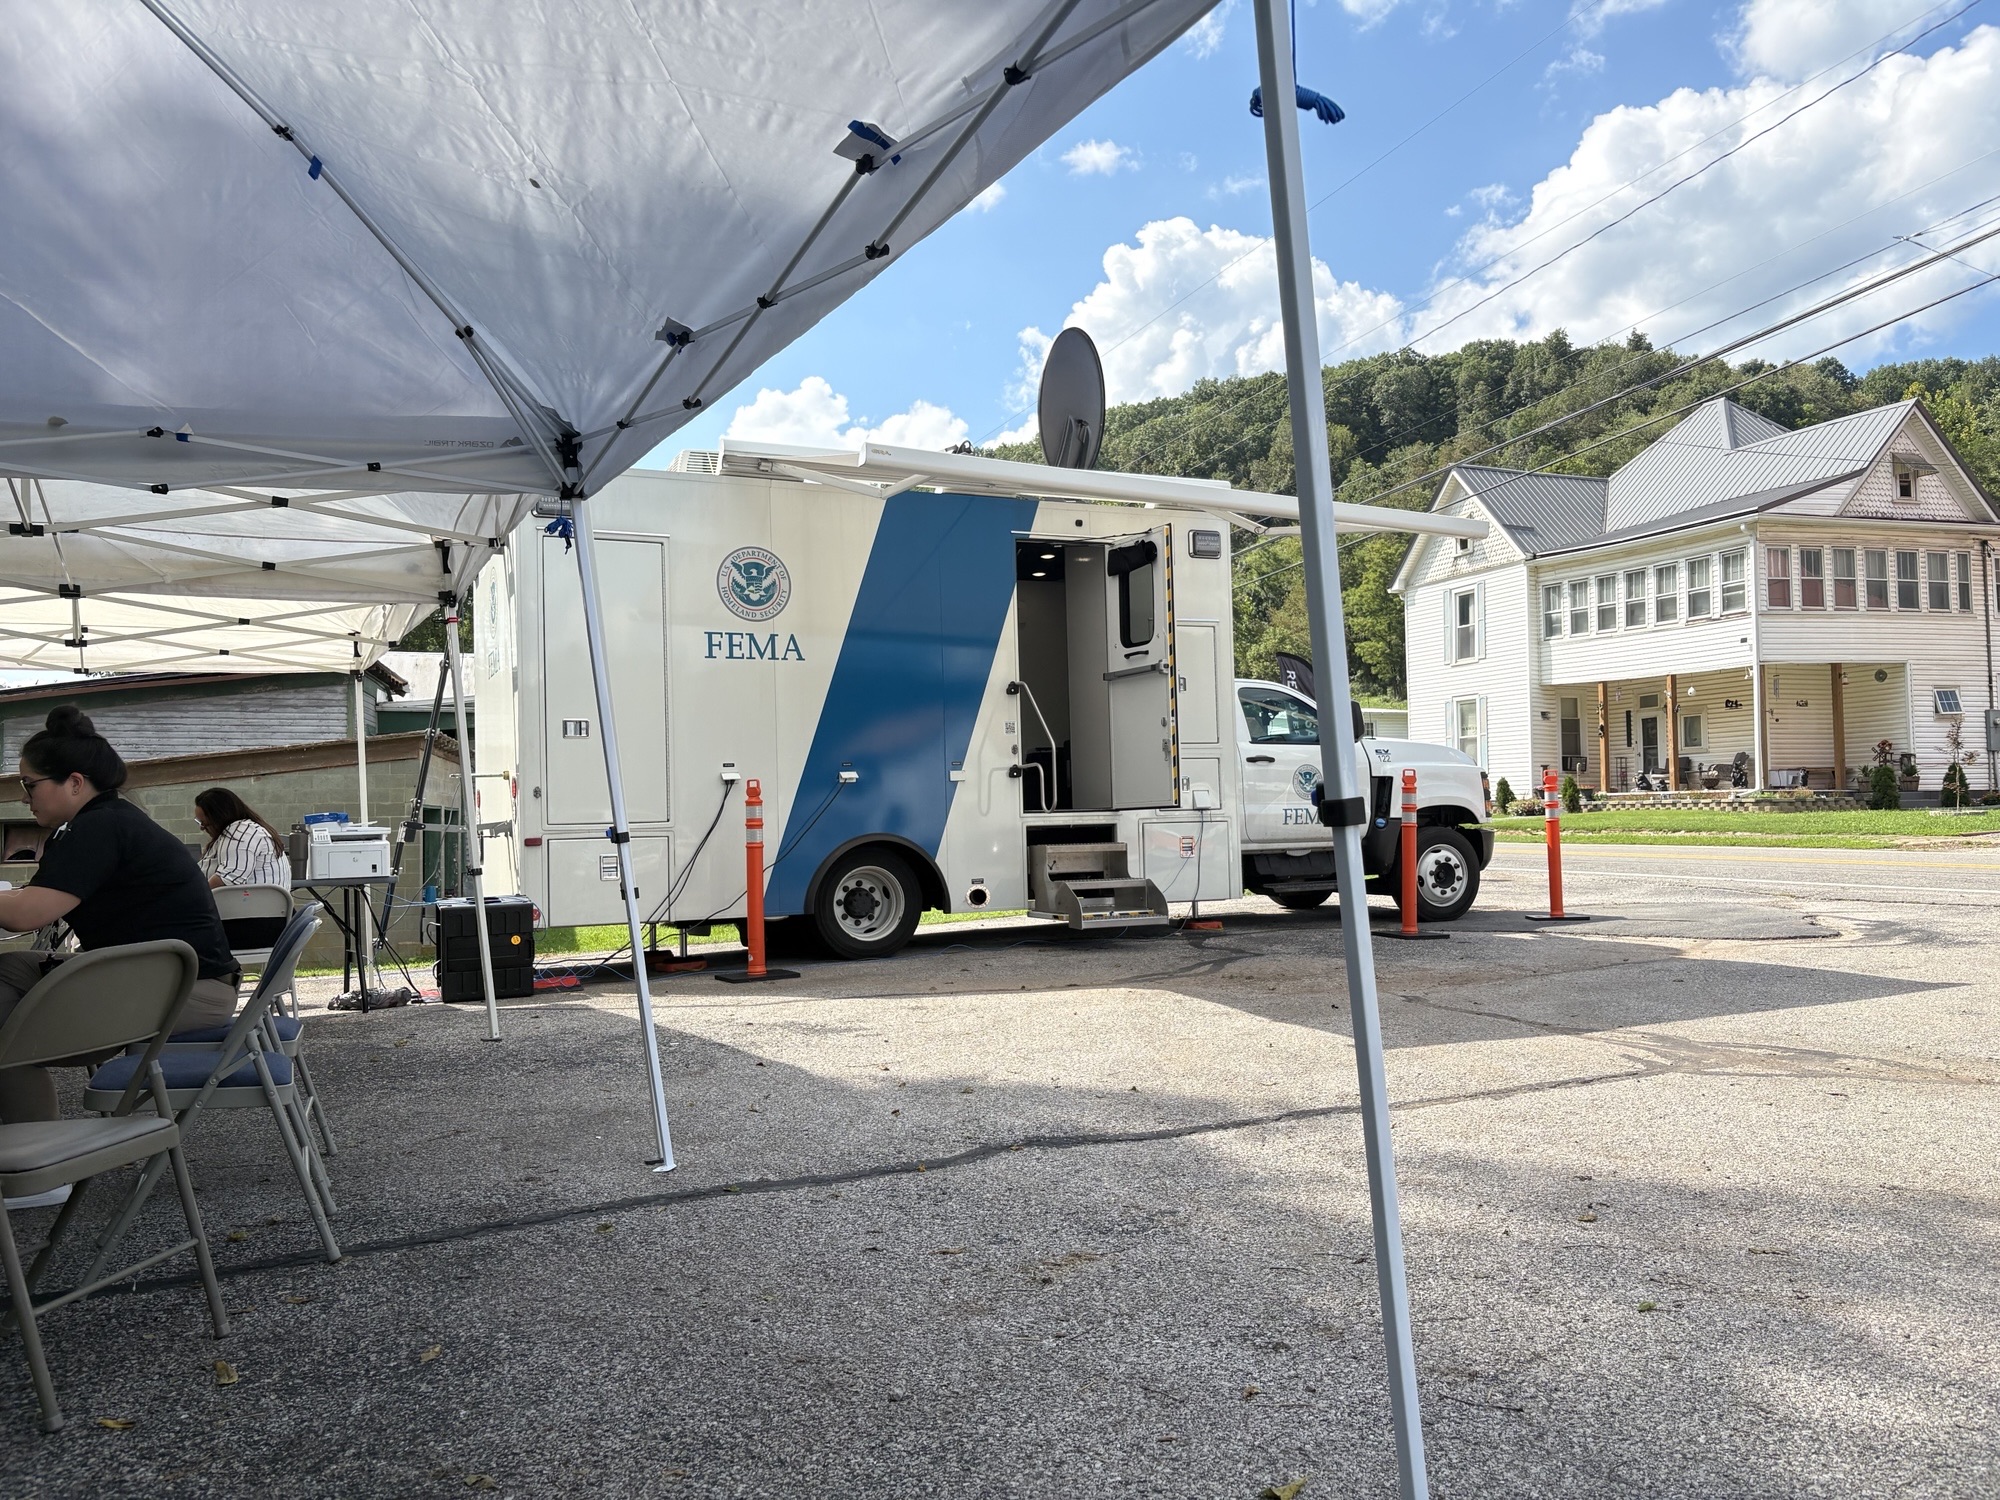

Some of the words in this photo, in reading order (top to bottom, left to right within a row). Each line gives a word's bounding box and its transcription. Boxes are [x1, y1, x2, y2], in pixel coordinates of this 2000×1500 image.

[731, 550, 782, 570] DEPARTMENT
[779, 570, 787, 581] OF
[721, 586, 757, 618] HOMELAND
[760, 588, 788, 618] SECURITY
[704, 631, 806, 661] FEMA
[1378, 754, 1391, 762] 122
[1282, 808, 1321, 825] FEM
